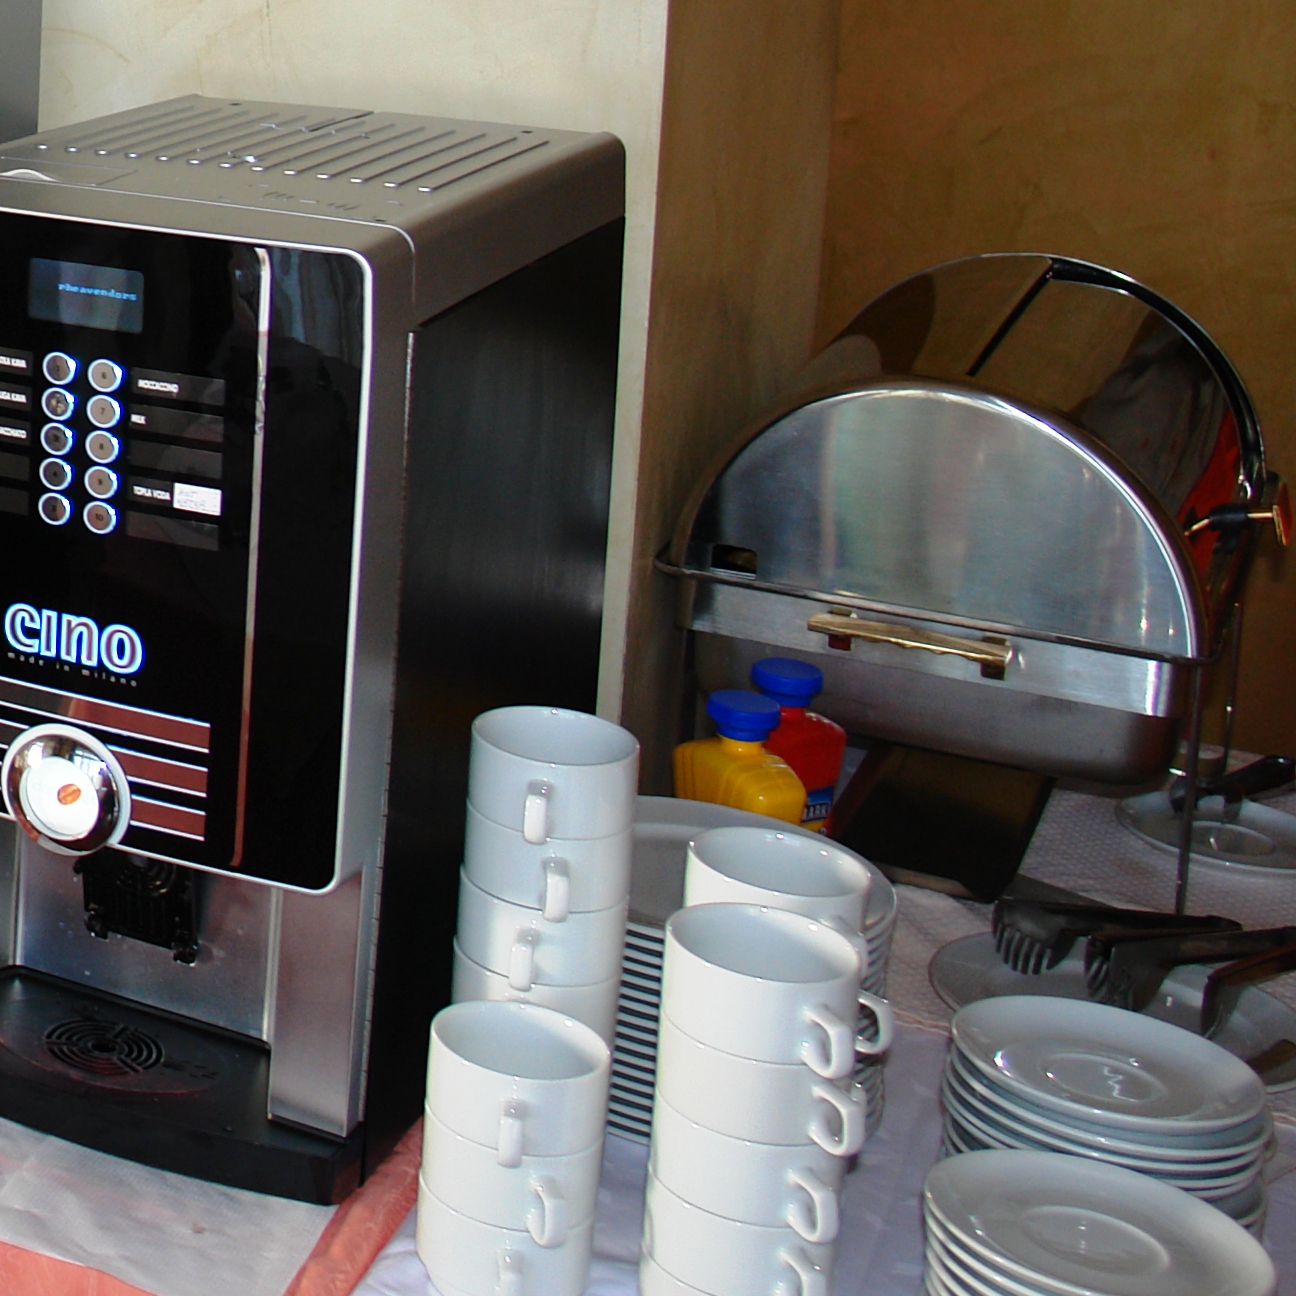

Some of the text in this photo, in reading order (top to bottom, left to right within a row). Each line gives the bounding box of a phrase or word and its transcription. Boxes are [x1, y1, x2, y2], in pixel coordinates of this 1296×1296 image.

[58, 283, 137, 301] rheavendors
[4, 603, 143, 674] cino
[8, 652, 137, 687] made in milano
